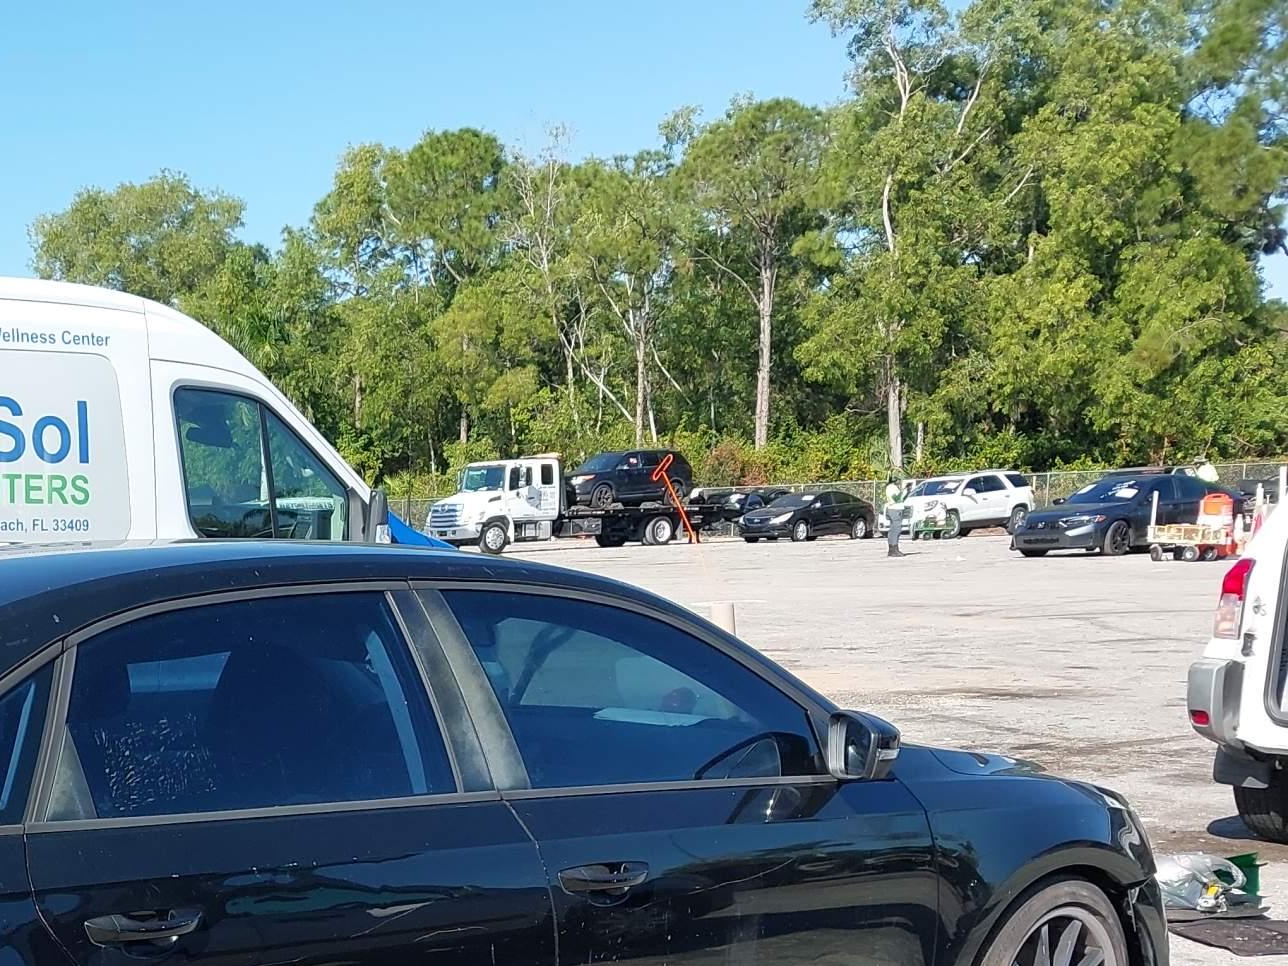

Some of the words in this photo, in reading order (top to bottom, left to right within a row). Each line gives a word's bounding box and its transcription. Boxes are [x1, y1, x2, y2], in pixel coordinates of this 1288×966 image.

[61, 330, 111, 347] Center
[32, 519, 48, 532] FL
[52, 519, 89, 532] 33409
